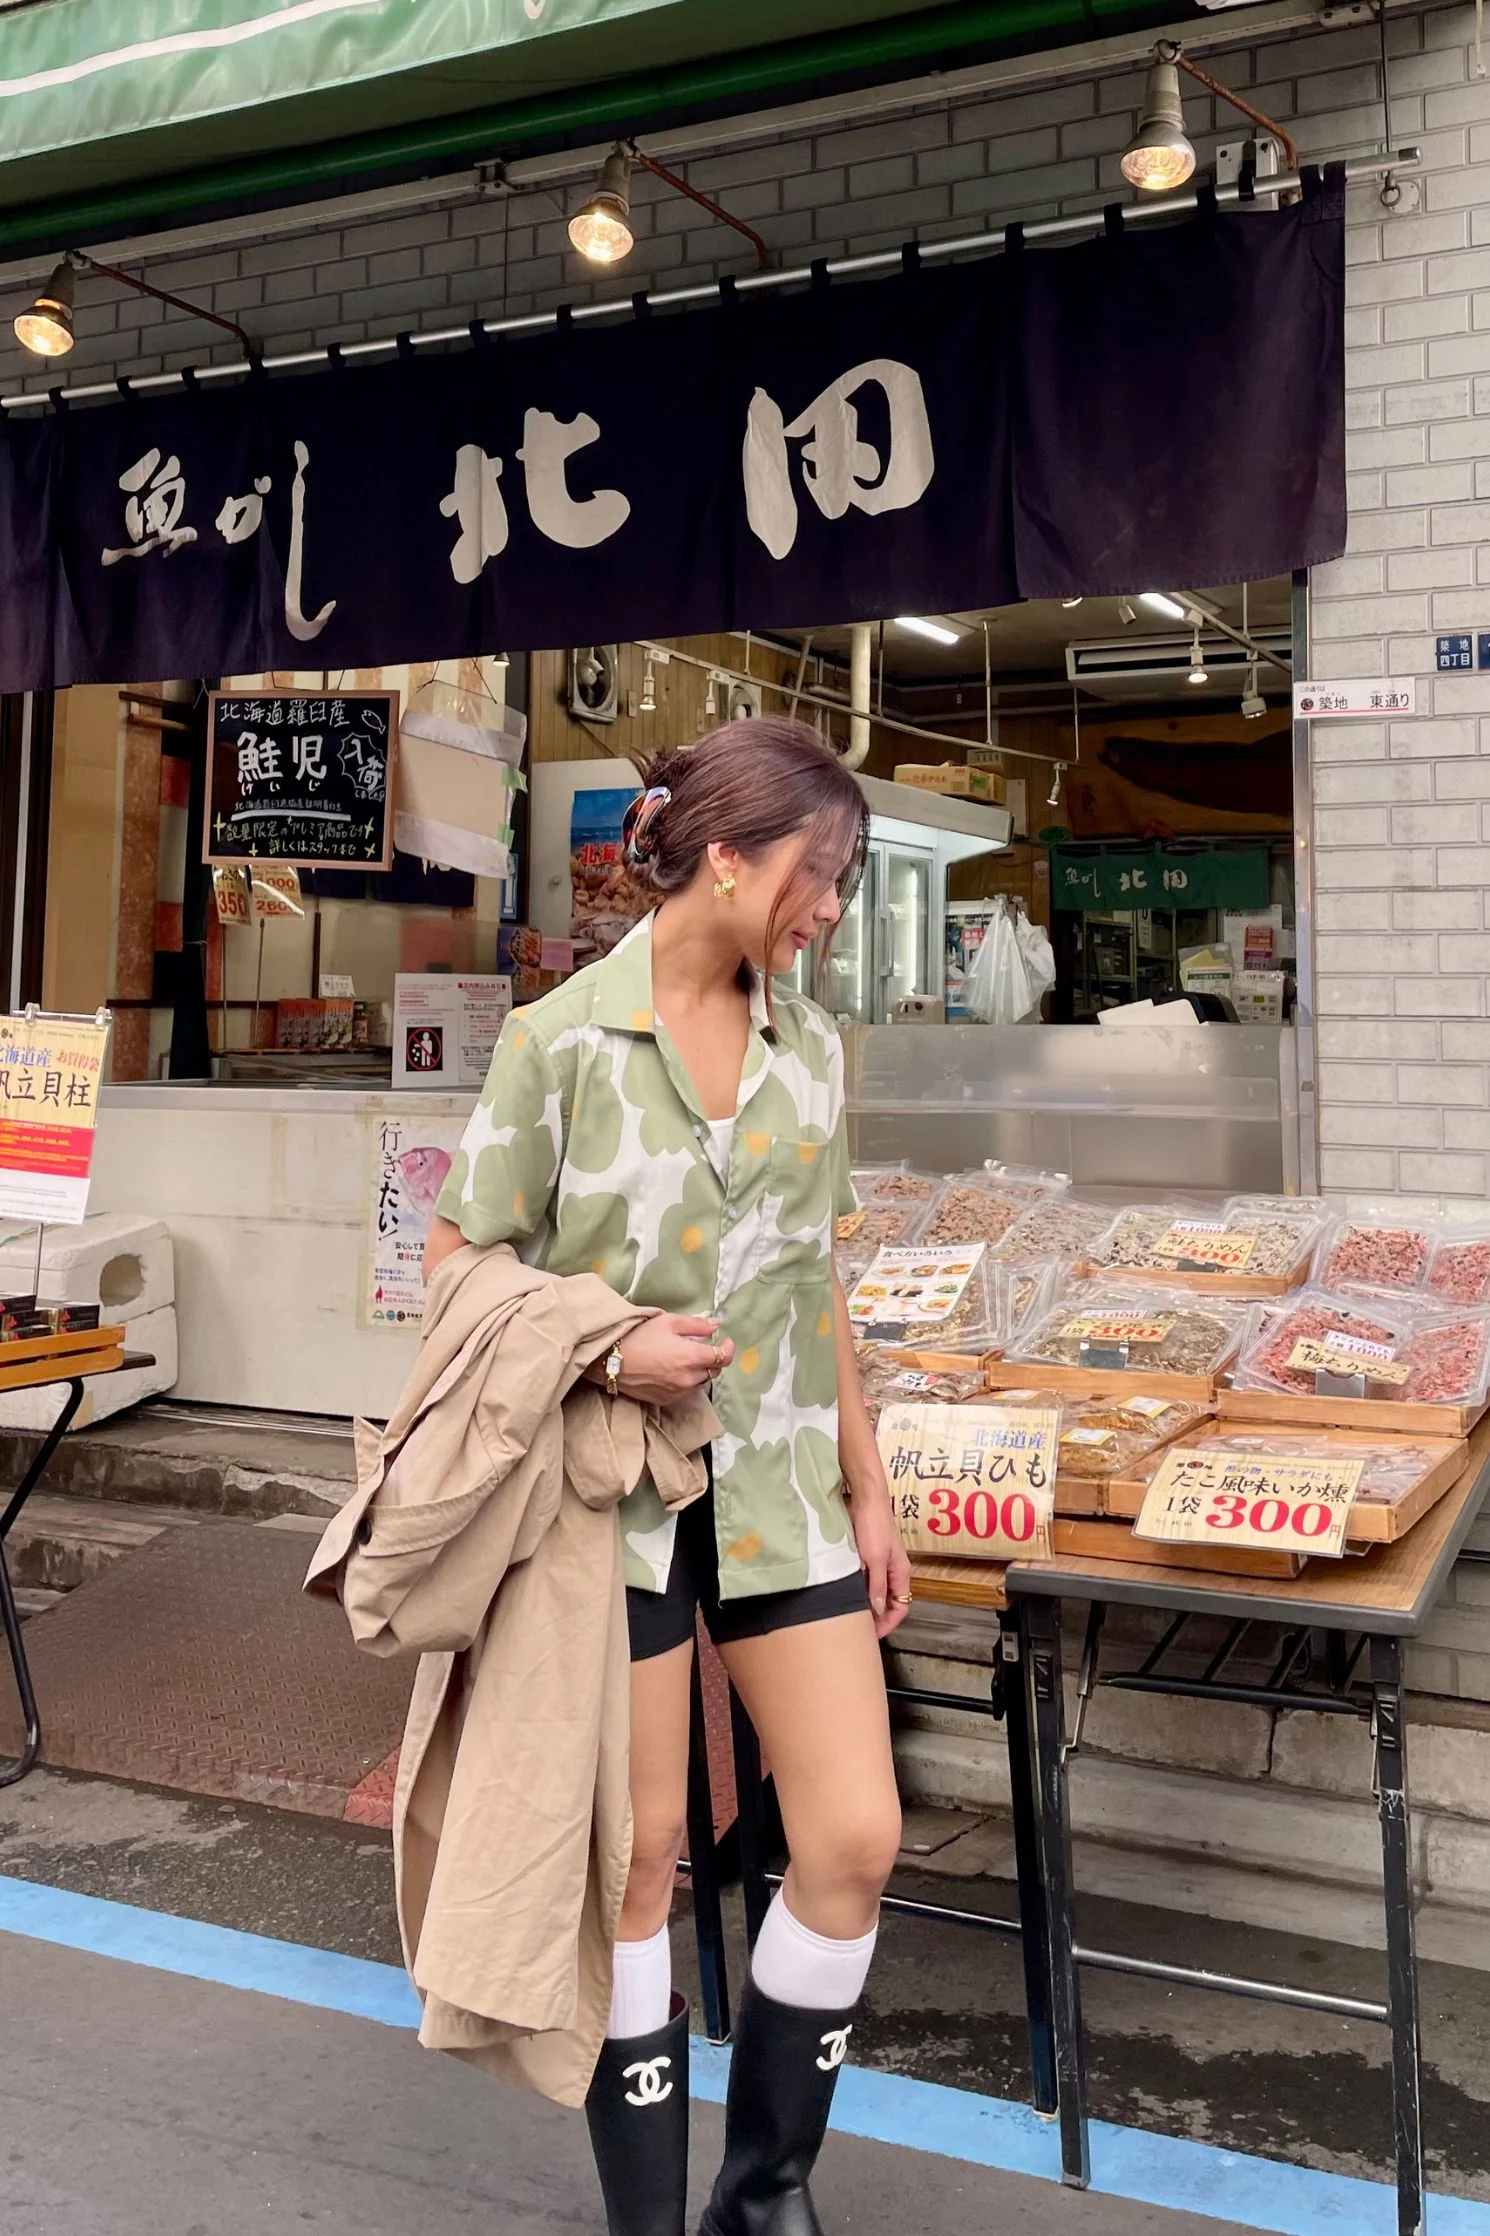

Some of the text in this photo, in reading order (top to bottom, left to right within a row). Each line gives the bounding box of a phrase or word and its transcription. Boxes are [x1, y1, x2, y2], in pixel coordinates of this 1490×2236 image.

[1440, 638, 1470, 652] 築地
[1440, 652, 1470, 667] 四丁目
[220, 699, 350, 727] 北海道羅臼産
[1319, 693, 1409, 710] 築地 東通り
[237, 731, 328, 784] 鮭児
[344, 738, 384, 791] 入荷
[269, 840, 357, 856] 詳しくはスタッフまで
[0, 1044, 52, 1068] 海道産
[972, 1429, 1047, 1451] 北海道産
[889, 1446, 1048, 1488] 帆立貝ひも
[1169, 1469, 1351, 1504] たこ風味いか燻
[1164, 1495, 1202, 1515] 1袋
